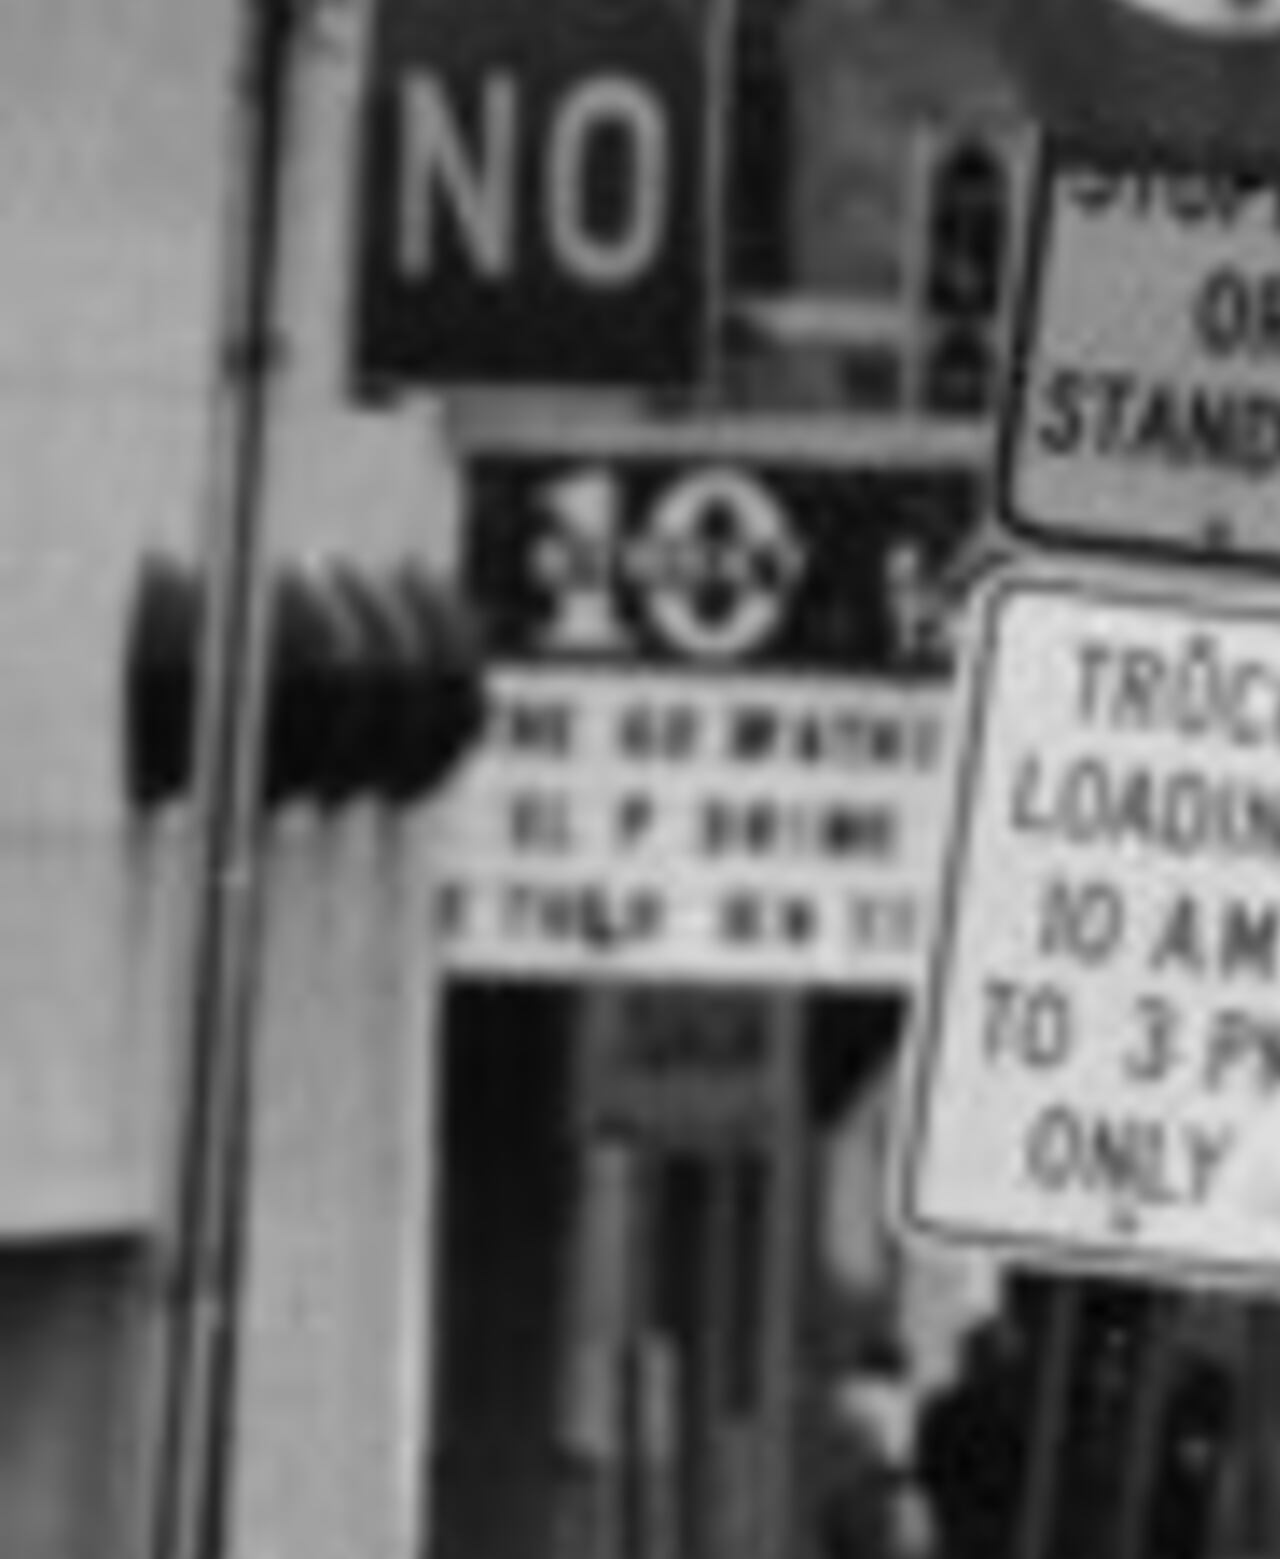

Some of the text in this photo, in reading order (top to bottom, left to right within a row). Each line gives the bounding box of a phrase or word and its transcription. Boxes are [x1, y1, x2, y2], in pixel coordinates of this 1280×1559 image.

[396, 68, 670, 282] NO
[1040, 875, 1124, 968] 10
[980, 975, 1072, 1072] TO
[1120, 992, 1182, 1086] 3
[1022, 1102, 1234, 1208] ONLY
